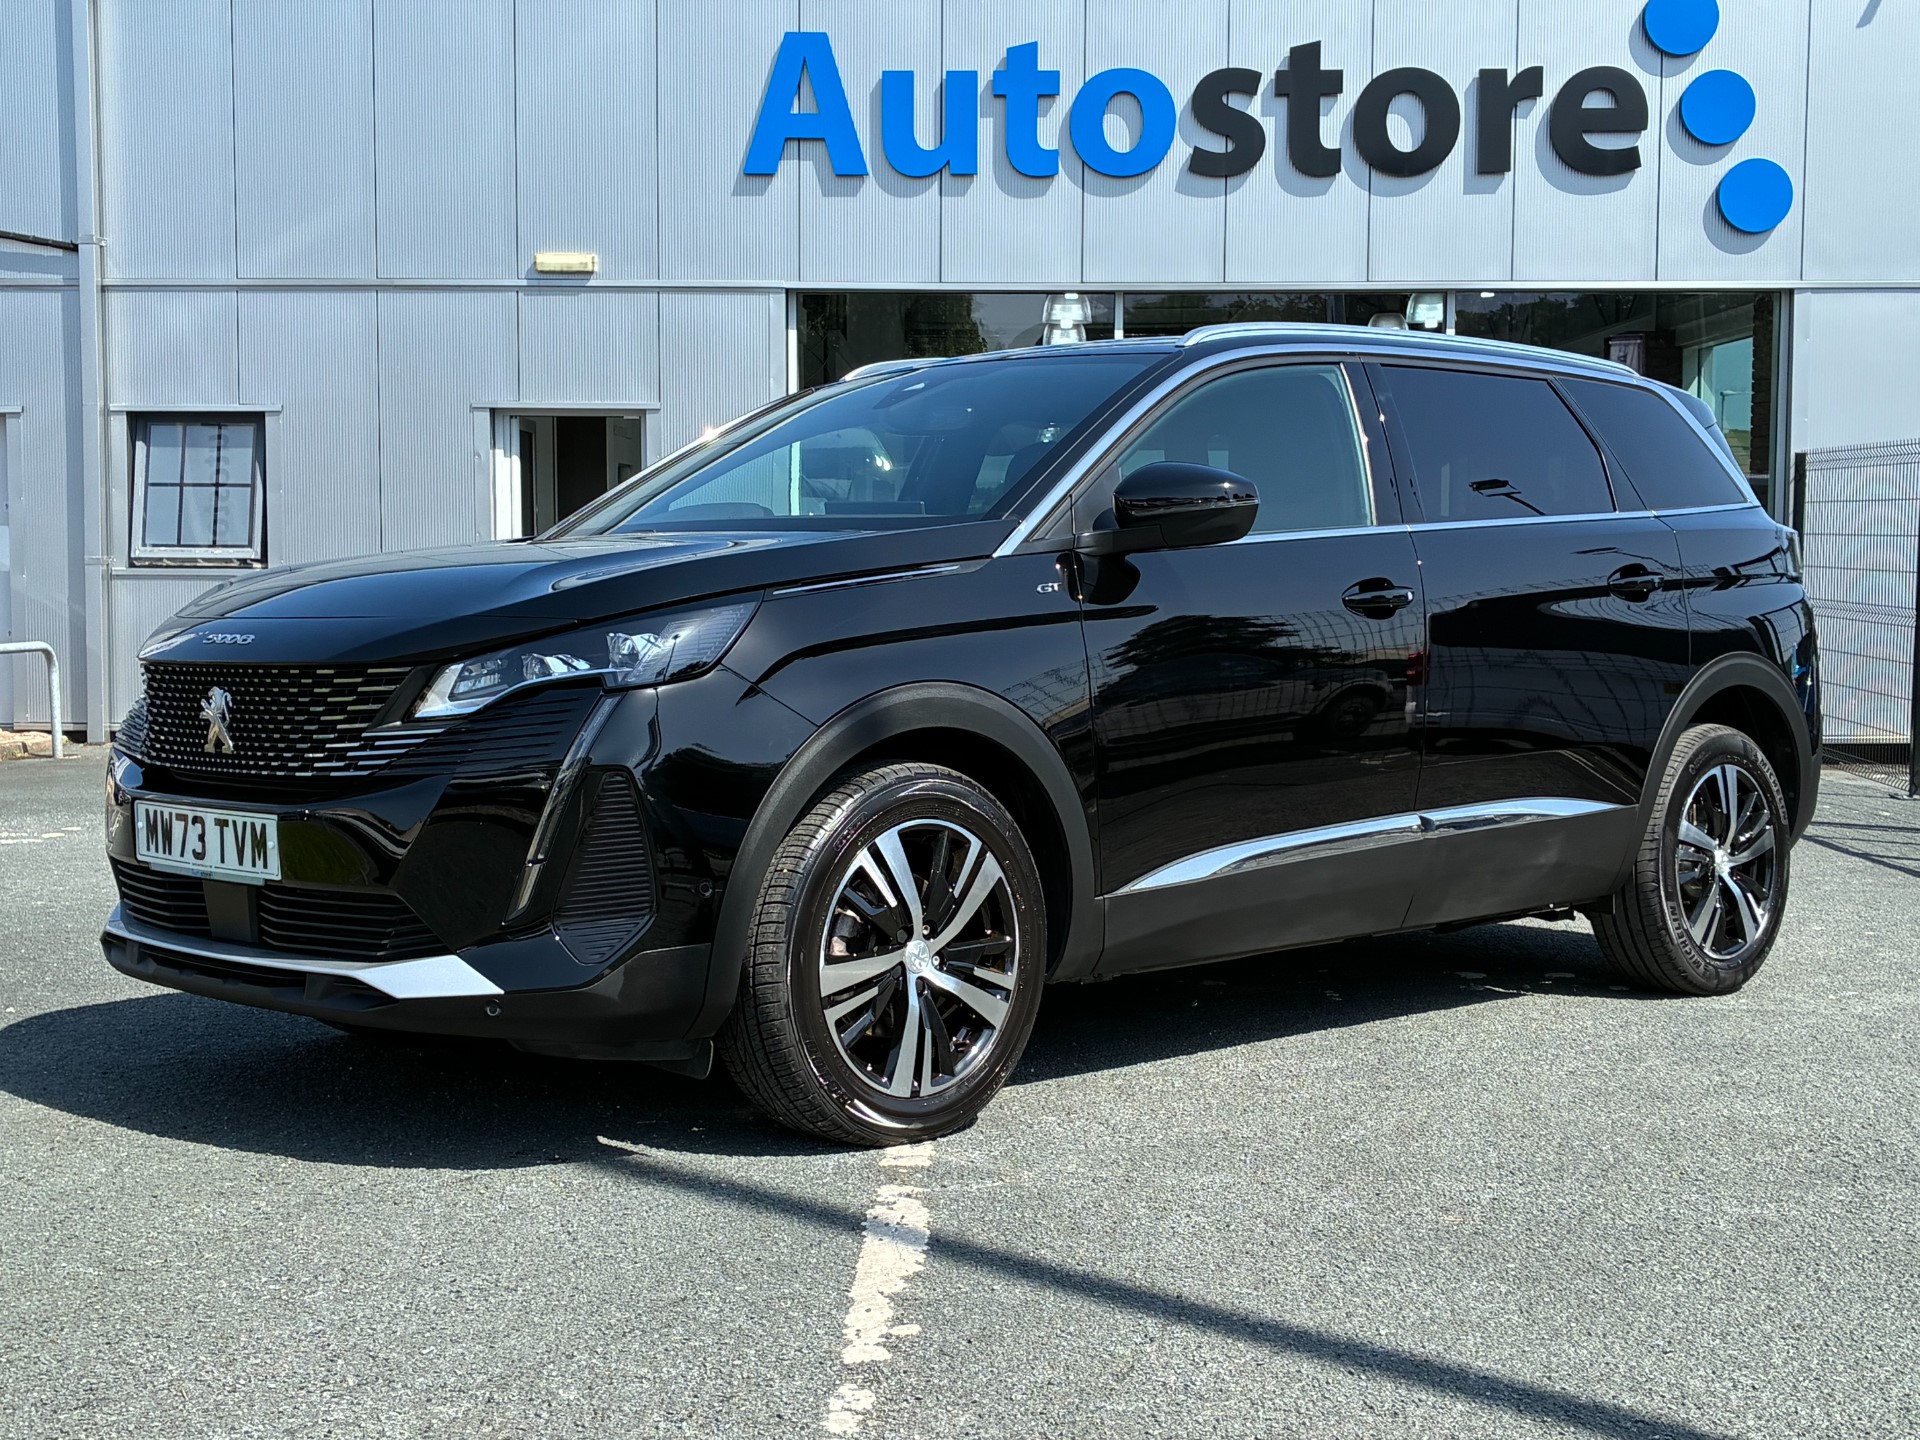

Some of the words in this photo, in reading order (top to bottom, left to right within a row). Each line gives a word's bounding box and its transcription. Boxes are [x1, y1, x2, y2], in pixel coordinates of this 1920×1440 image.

[743, 31, 1649, 177] Autostore
[1036, 582, 1062, 593] GT
[202, 633, 256, 645] 5008
[1758, 757, 1788, 821] MICHELIN
[144, 807, 206, 861] MW73
[213, 818, 268, 869] TVM
[1668, 904, 1703, 969] MICHELIN
